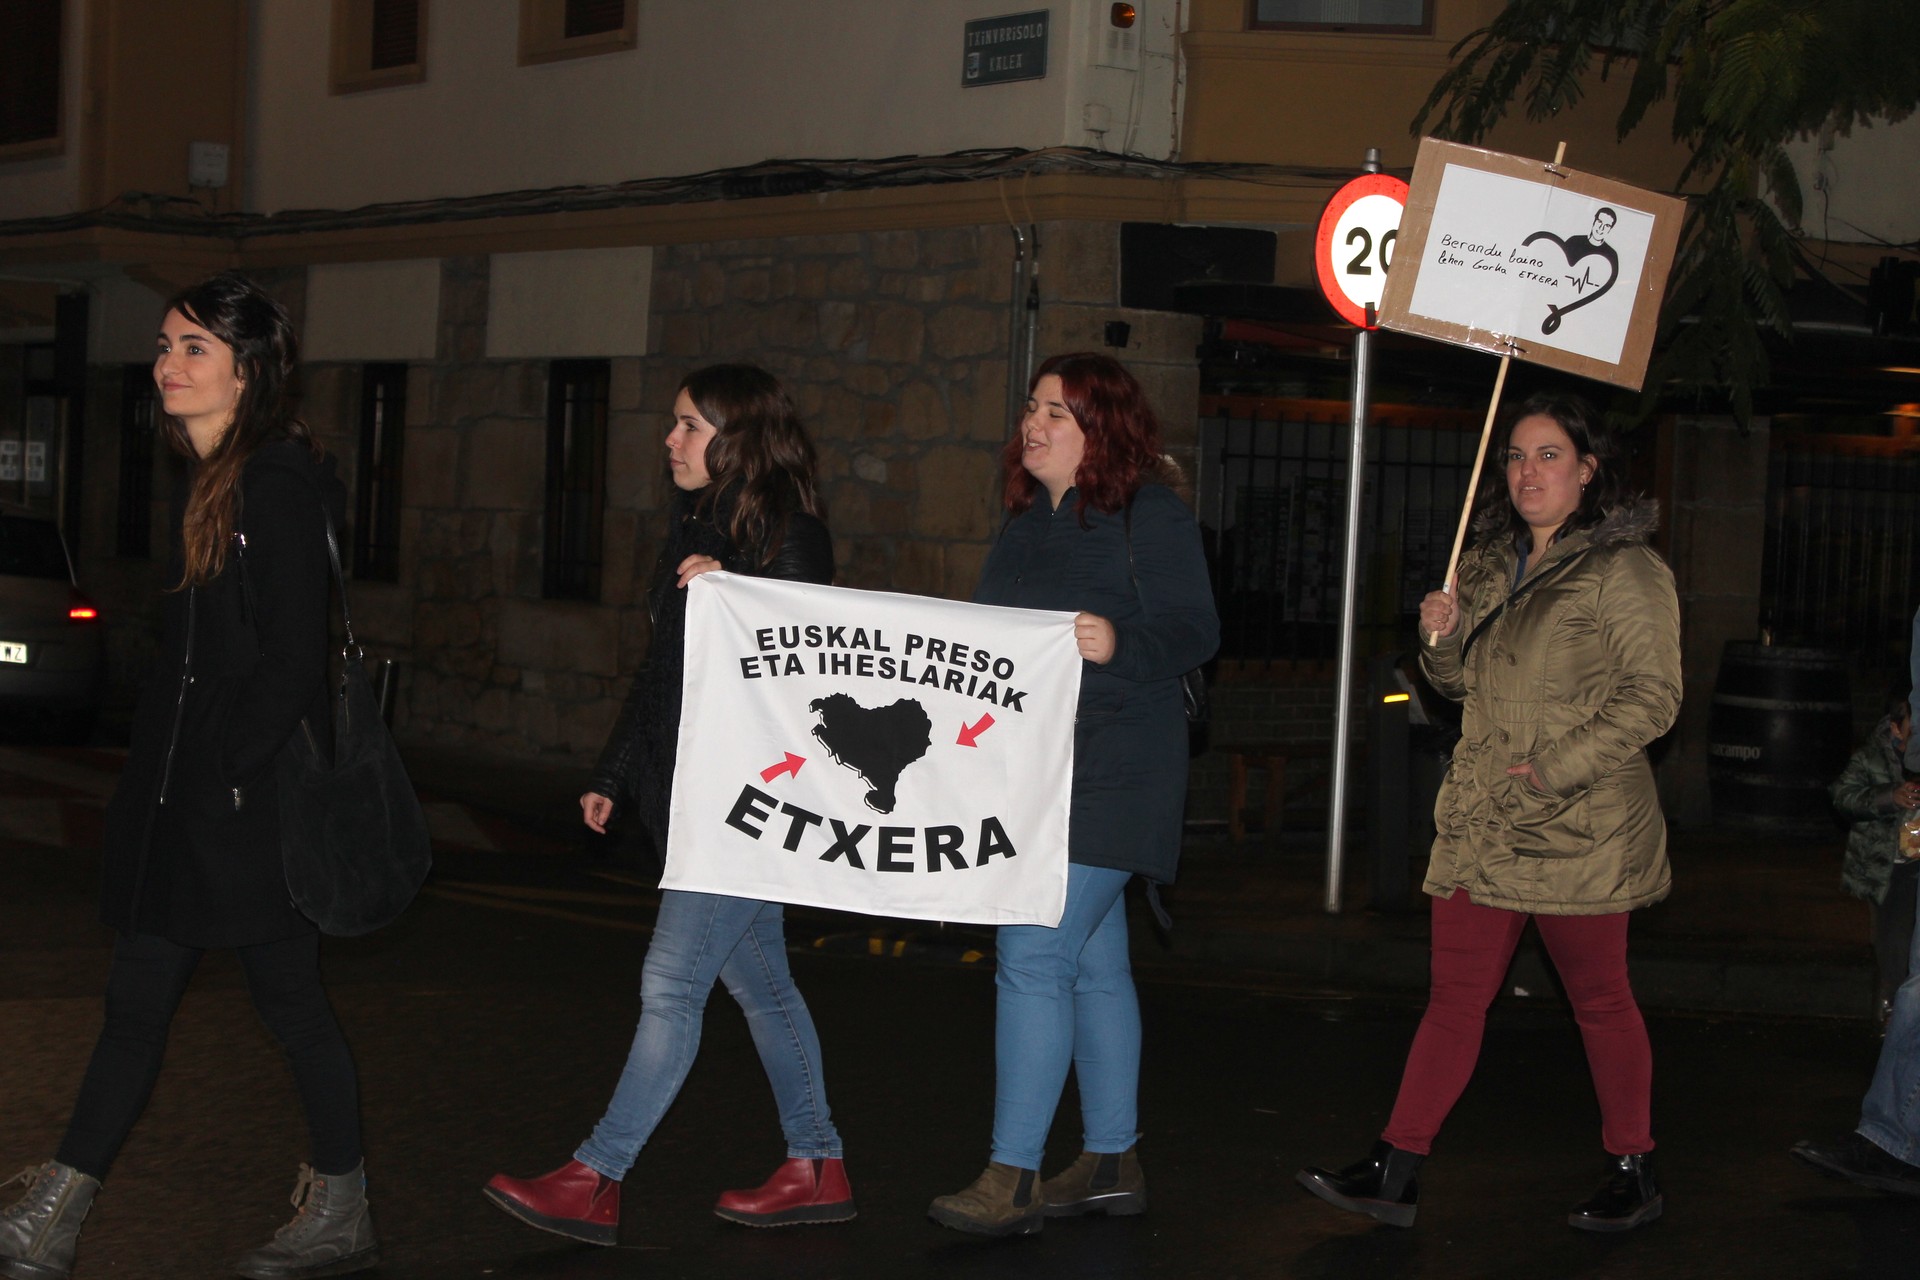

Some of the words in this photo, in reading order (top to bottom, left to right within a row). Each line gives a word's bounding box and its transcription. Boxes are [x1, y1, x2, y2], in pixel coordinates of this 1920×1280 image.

[989, 54, 1023, 72] KALEA
[1442, 234, 1501, 257] Berandu
[1438, 250, 1463, 266] lehen
[1473, 260, 1506, 274] Gorka
[1519, 271, 1558, 287] ETXERA
[756, 626, 890, 652] EUSKAL
[905, 634, 1014, 680] PRESO
[740, 654, 805, 678] ETA
[819, 653, 1027, 712] IHESLARIAK
[725, 784, 1016, 872] ETXERA
